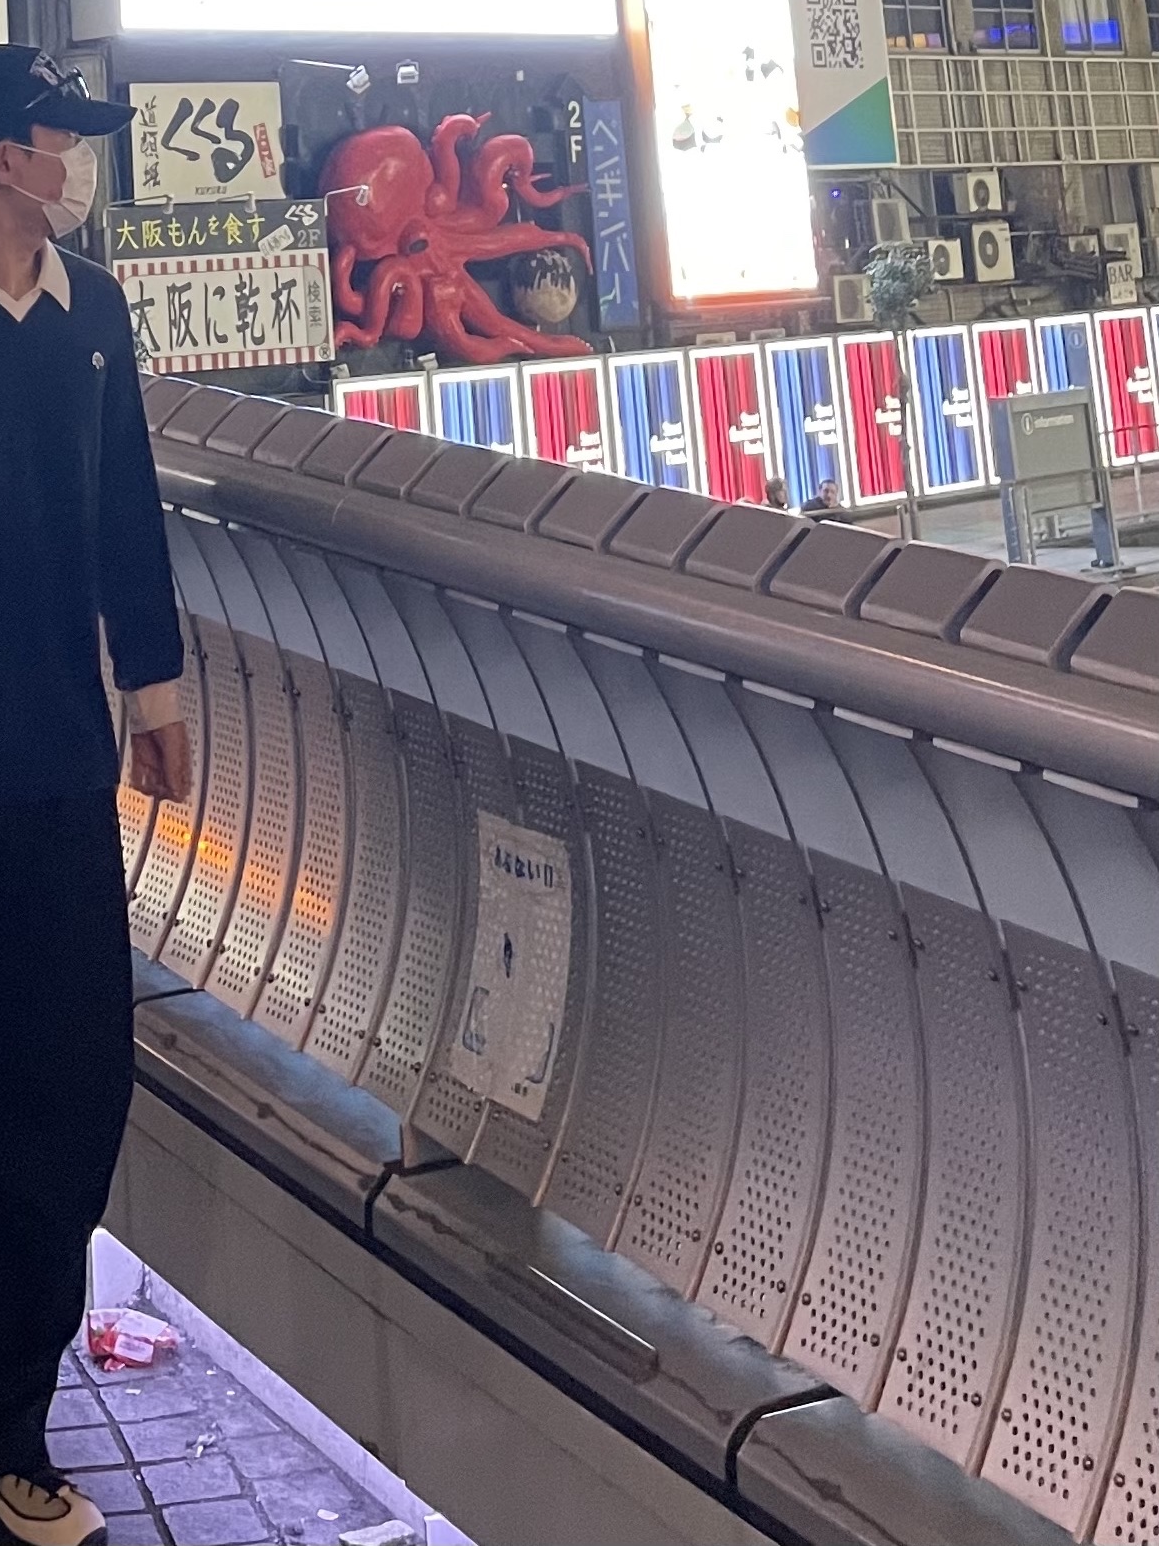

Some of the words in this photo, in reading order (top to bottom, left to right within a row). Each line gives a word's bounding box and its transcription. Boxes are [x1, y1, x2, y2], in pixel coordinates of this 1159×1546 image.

[160, 97, 255, 184] くくる
[568, 100, 583, 163] 2F
[116, 212, 266, 250] 大阪もんを食す
[297, 228, 321, 248] 2F
[1108, 264, 1136, 285] BAR
[129, 271, 301, 353] 大阪に乾杯
